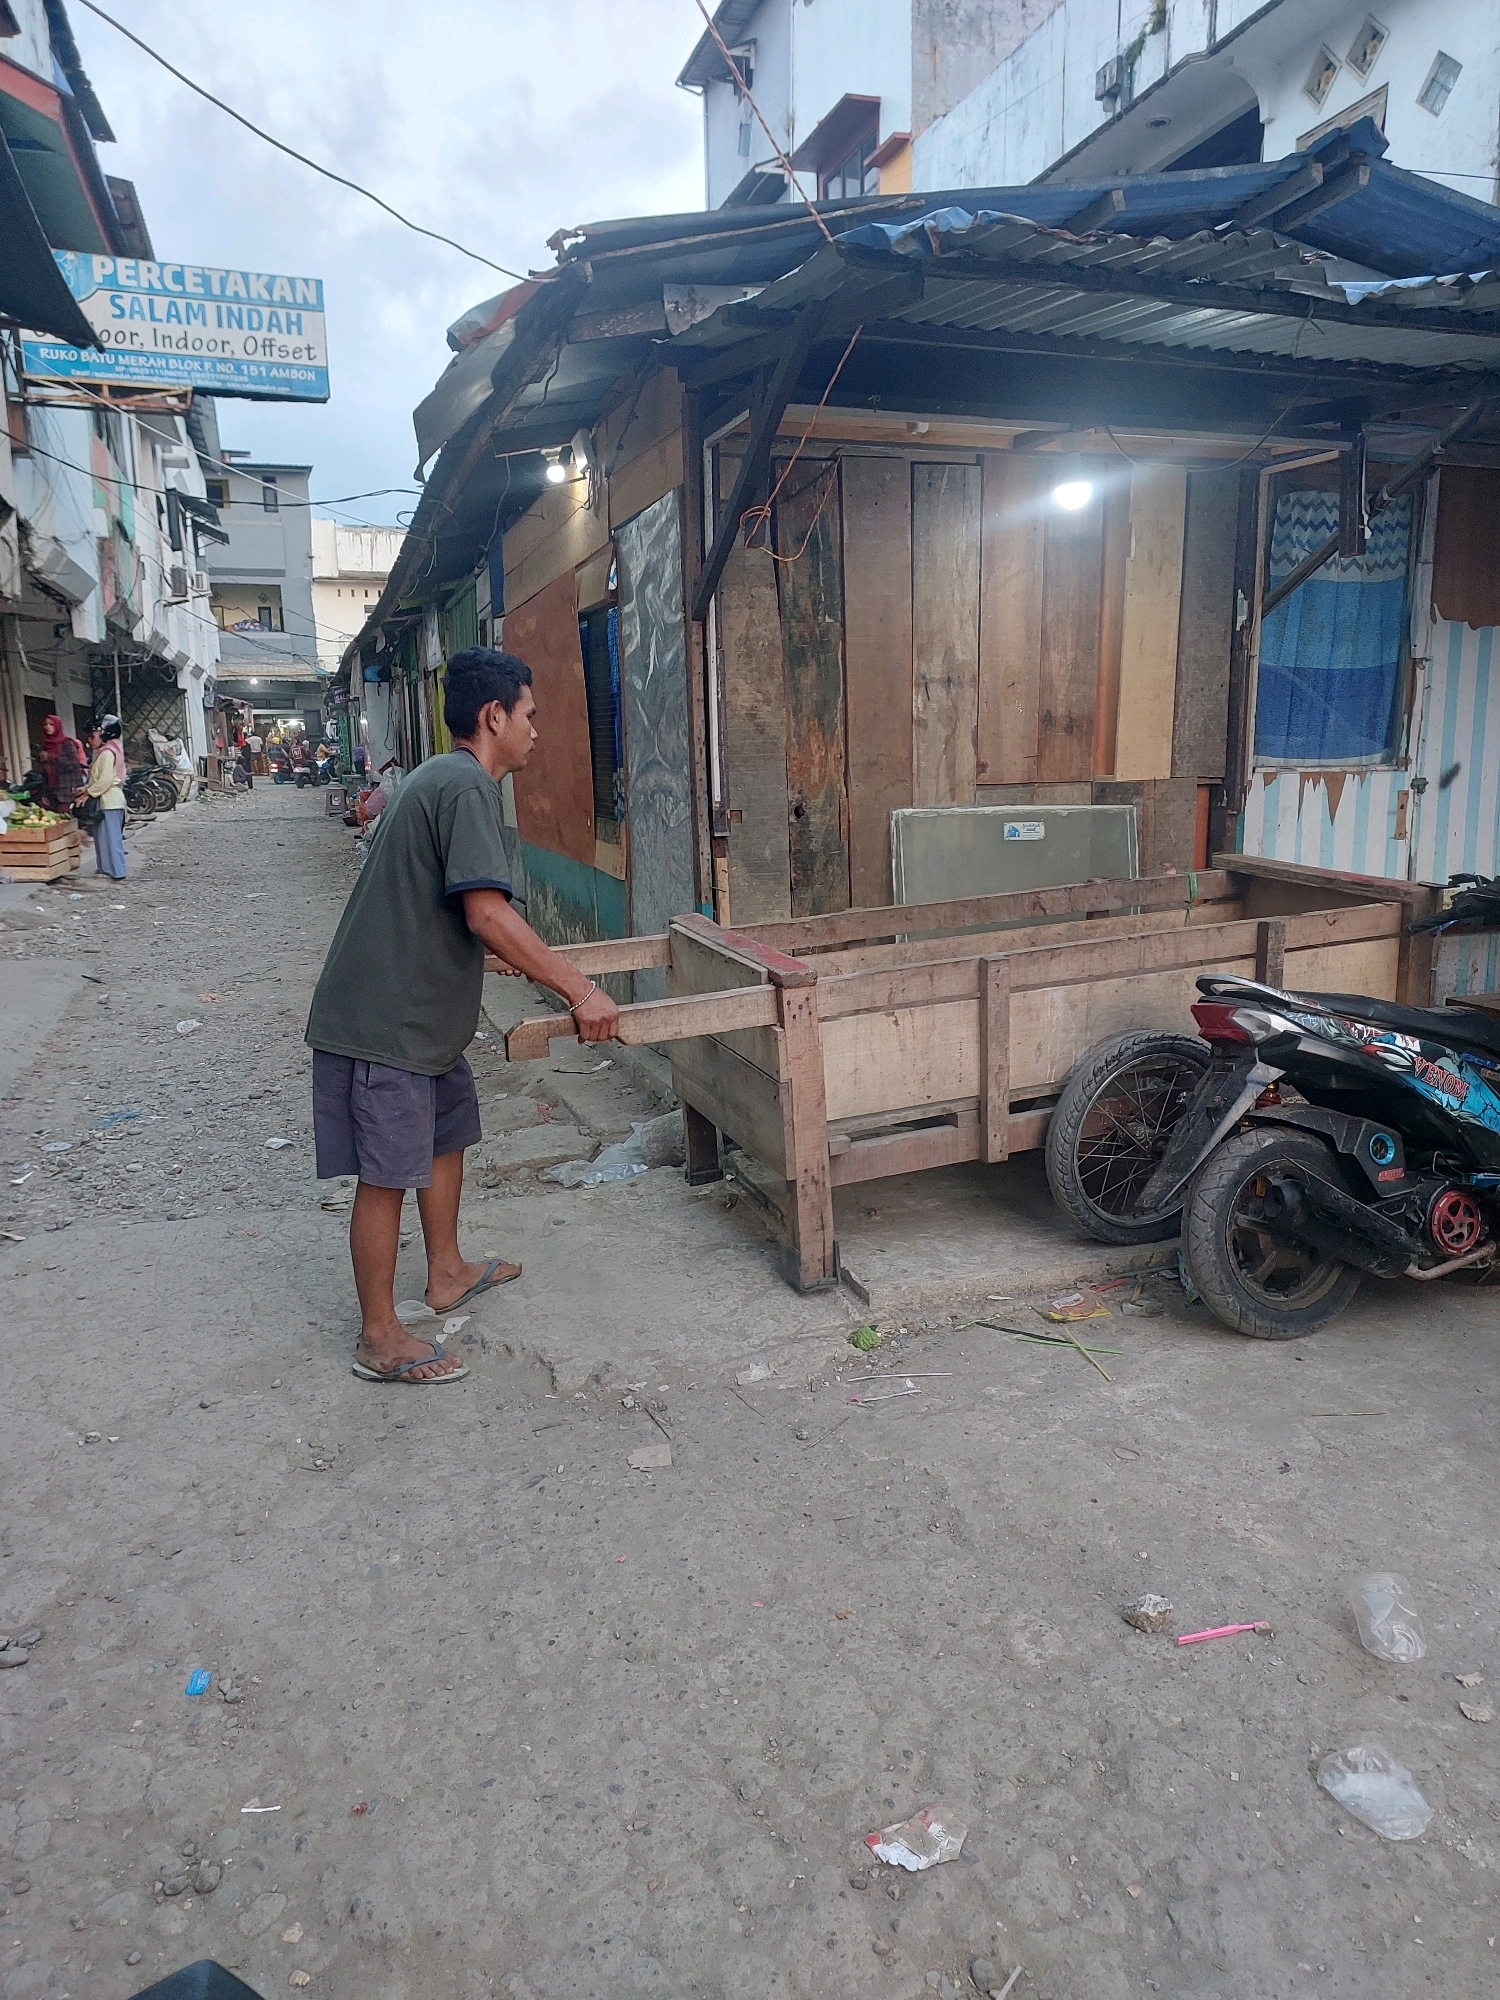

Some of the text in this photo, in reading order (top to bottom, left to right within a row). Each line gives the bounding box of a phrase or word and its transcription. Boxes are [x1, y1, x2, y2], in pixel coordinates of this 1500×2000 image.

[92, 254, 317, 305] PERCETAKAN
[110, 294, 303, 336] SALAM INDAH
[39, 347, 78, 361] RUKO
[81, 350, 115, 365] BATU
[118, 354, 167, 369] MERAH
[168, 358, 203, 372] BLOK
[241, 365, 267, 377] 151
[270, 368, 316, 381] AMBON
[153, 326, 235, 356] Indoor,
[243, 335, 317, 361] Offset
[1413, 1056, 1469, 1101] VENOM
